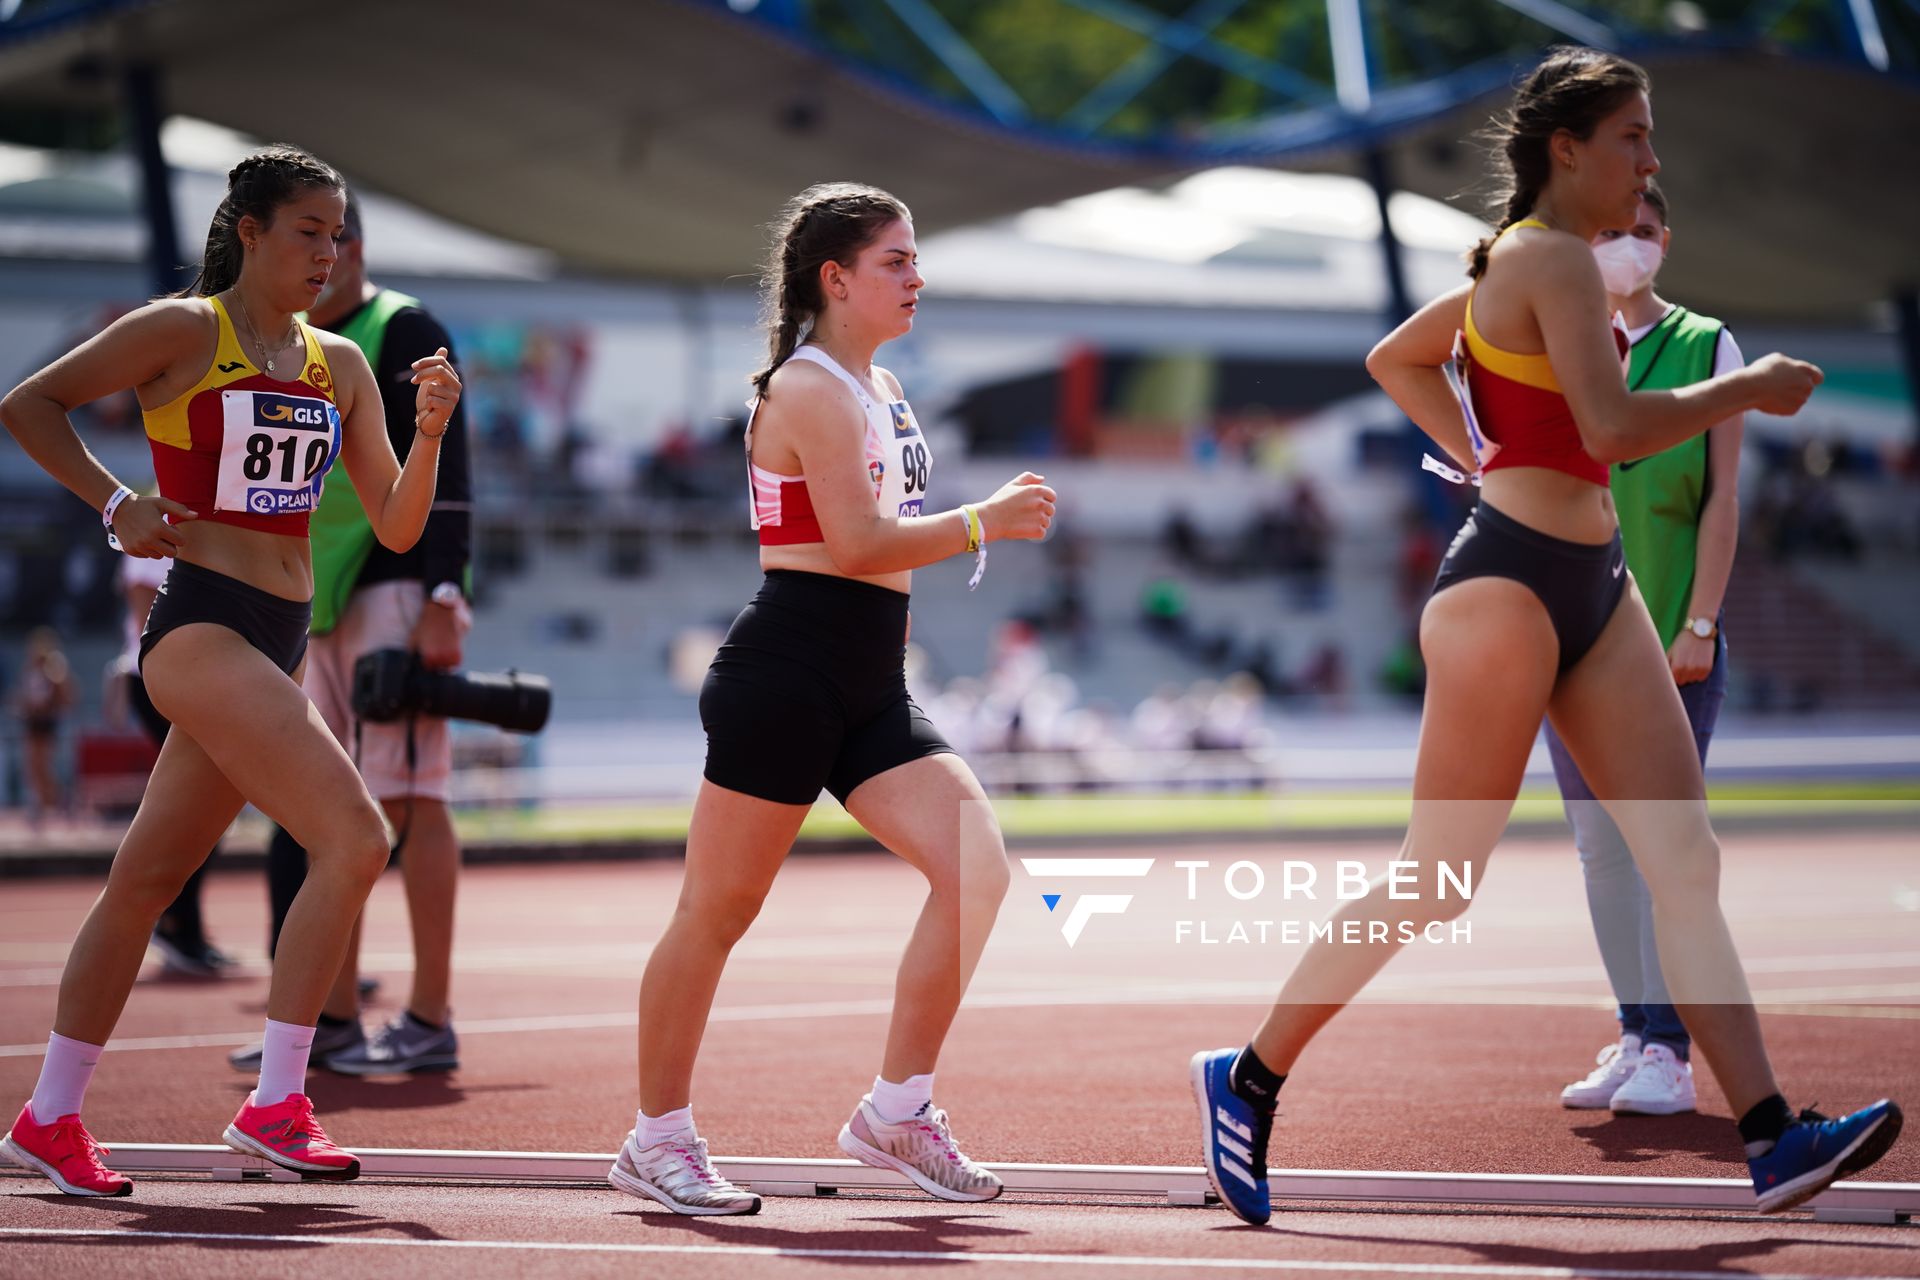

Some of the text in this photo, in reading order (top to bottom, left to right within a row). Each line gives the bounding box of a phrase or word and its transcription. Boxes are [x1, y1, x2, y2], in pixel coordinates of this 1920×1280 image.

[293, 408, 323, 424] GLS
[243, 433, 329, 482] 810
[278, 493, 310, 507] PLAN
